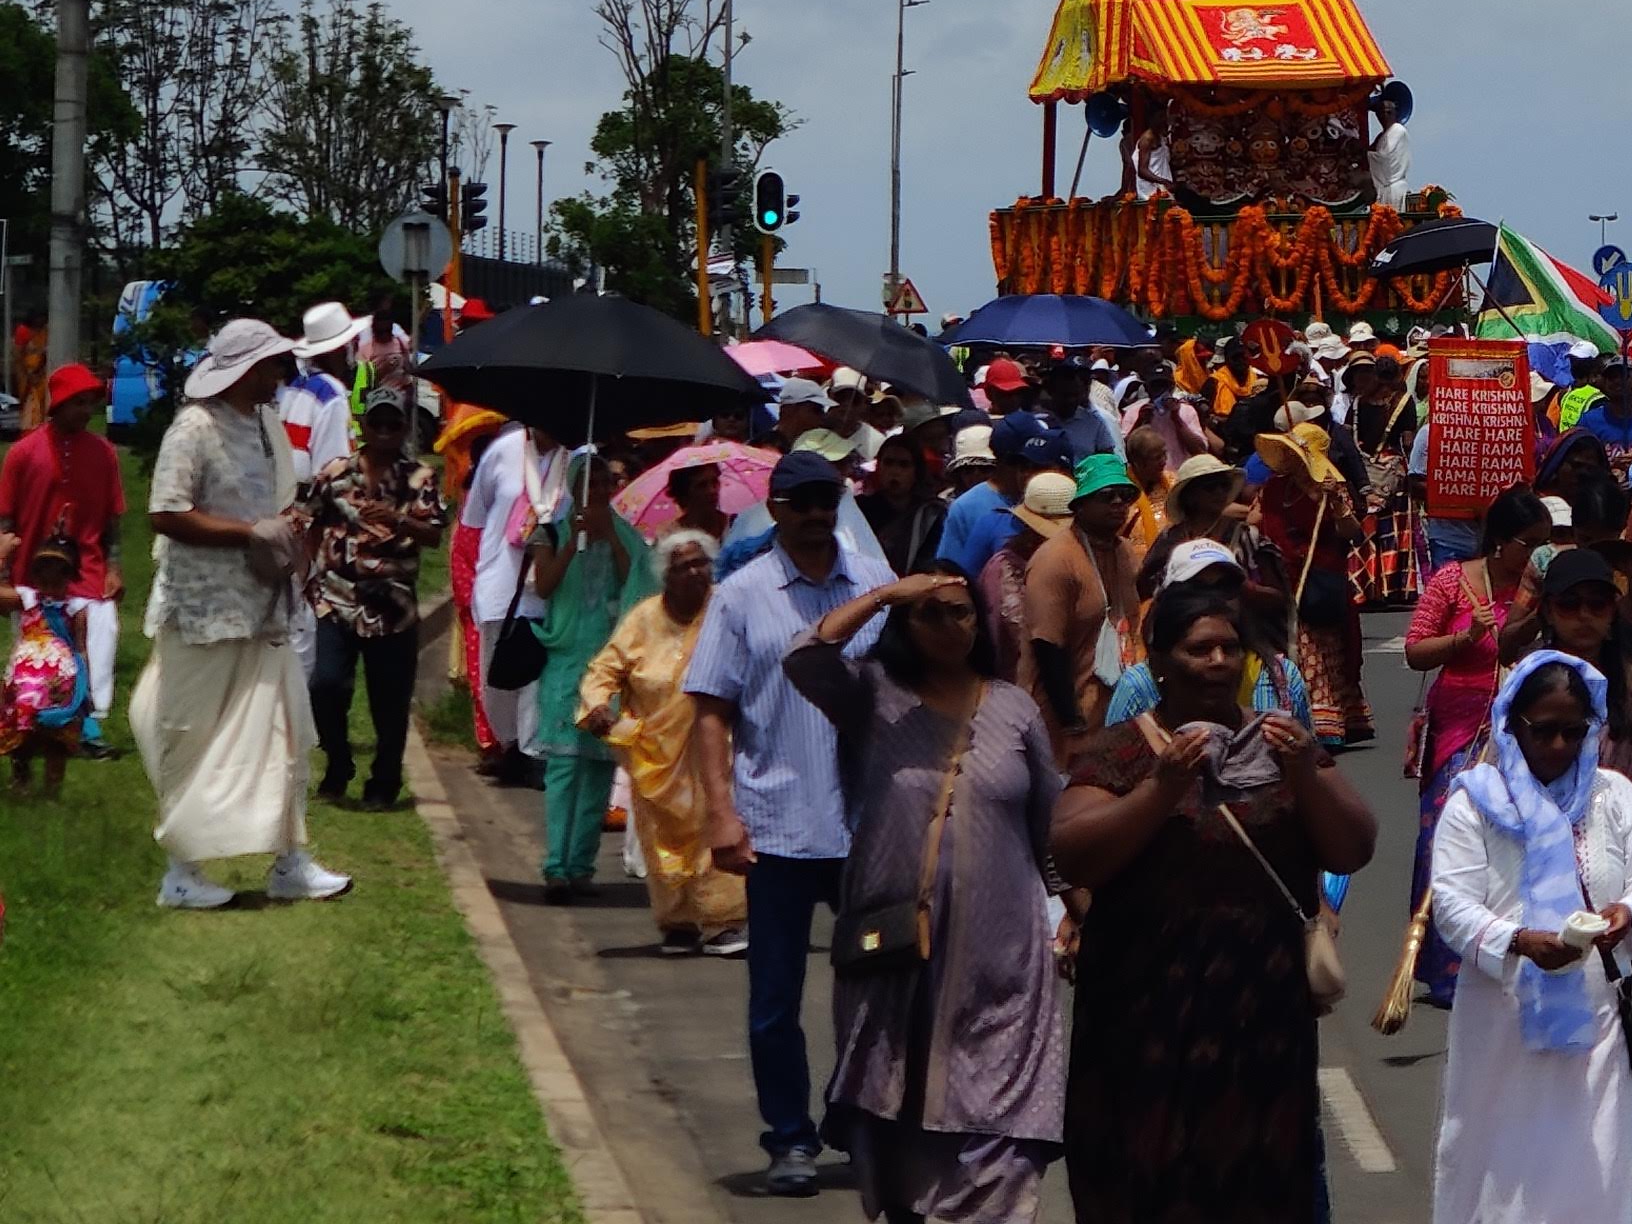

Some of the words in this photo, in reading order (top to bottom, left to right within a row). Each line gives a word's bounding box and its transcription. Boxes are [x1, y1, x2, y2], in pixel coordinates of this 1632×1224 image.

[1435, 387, 1468, 401] HARE
[1471, 389, 1525, 402] KRISHNA
[1435, 401, 1468, 414] HARE
[1471, 402, 1525, 415] KRISHNA
[1432, 413, 1480, 426] KRISHNA
[1482, 415, 1528, 427] KRISHNA
[1443, 427, 1481, 440] HARE
[1484, 428, 1523, 441] HARE
[1440, 441, 1478, 454] HARE
[1482, 443, 1524, 455] RAMA
[1440, 456, 1478, 468] HARE
[1481, 457, 1524, 469] RAMA
[1434, 470, 1476, 482] RAMA
[1481, 472, 1524, 483] RAMA
[1439, 483, 1476, 496] HARE
